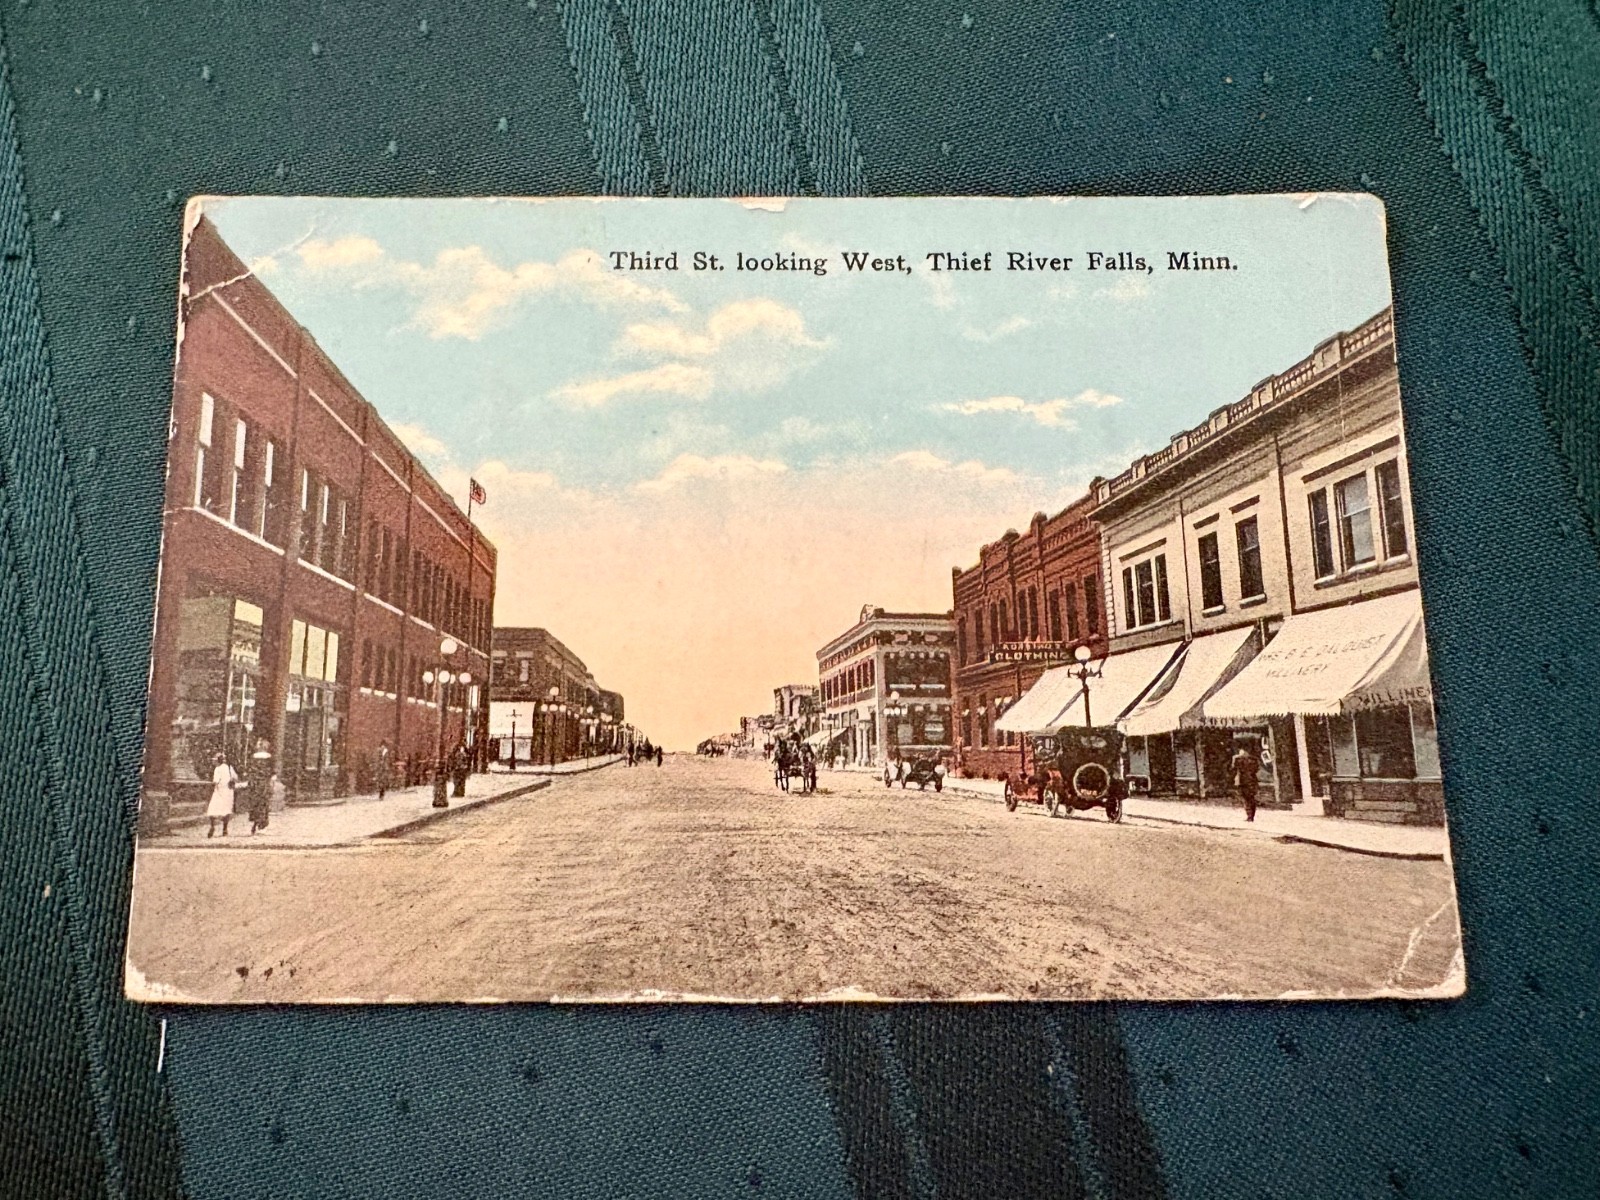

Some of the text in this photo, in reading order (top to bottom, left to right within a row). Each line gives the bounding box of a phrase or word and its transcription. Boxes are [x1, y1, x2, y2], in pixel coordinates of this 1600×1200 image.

[609, 251, 1238, 276] Third St. looking West, Thief River Falls, Minn.
